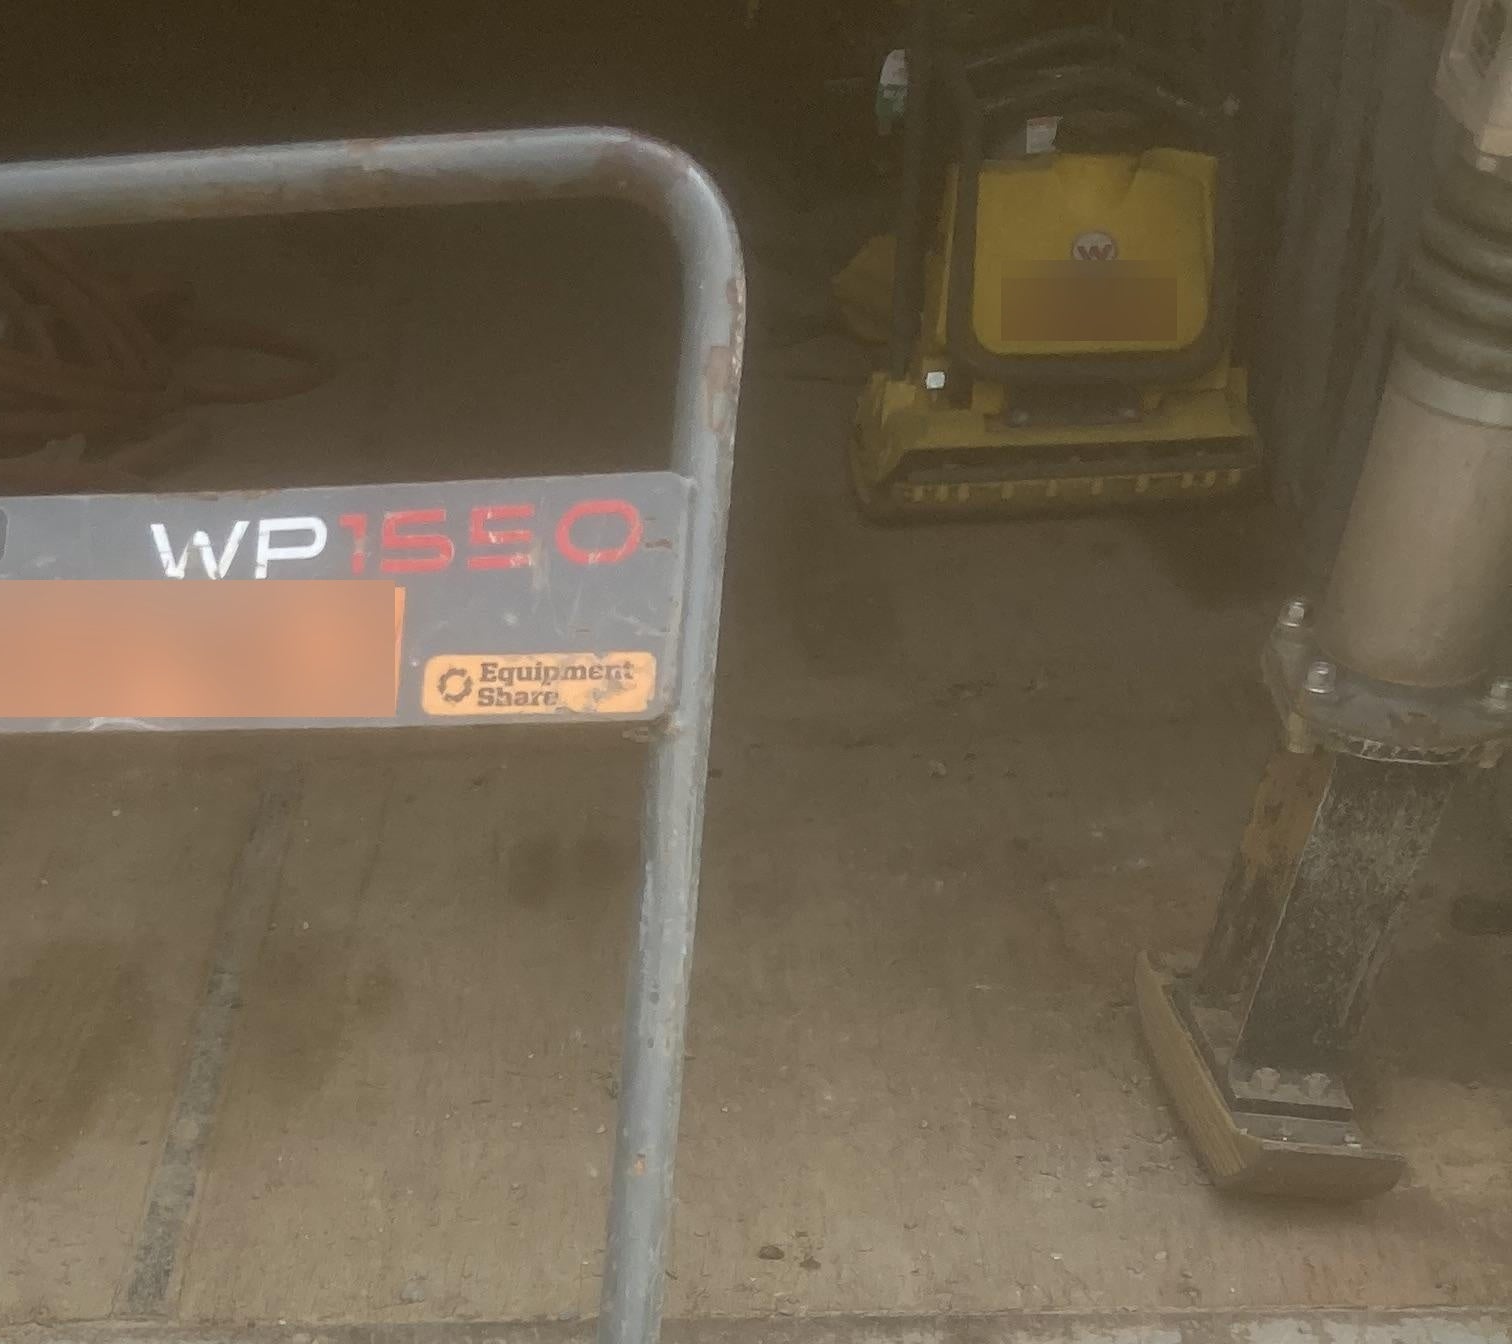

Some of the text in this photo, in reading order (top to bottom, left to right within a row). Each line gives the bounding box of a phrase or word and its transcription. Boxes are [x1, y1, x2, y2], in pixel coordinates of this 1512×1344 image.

[150, 499, 644, 580] WP1550
[479, 661, 634, 686] Equipment
[477, 687, 559, 707] Share
